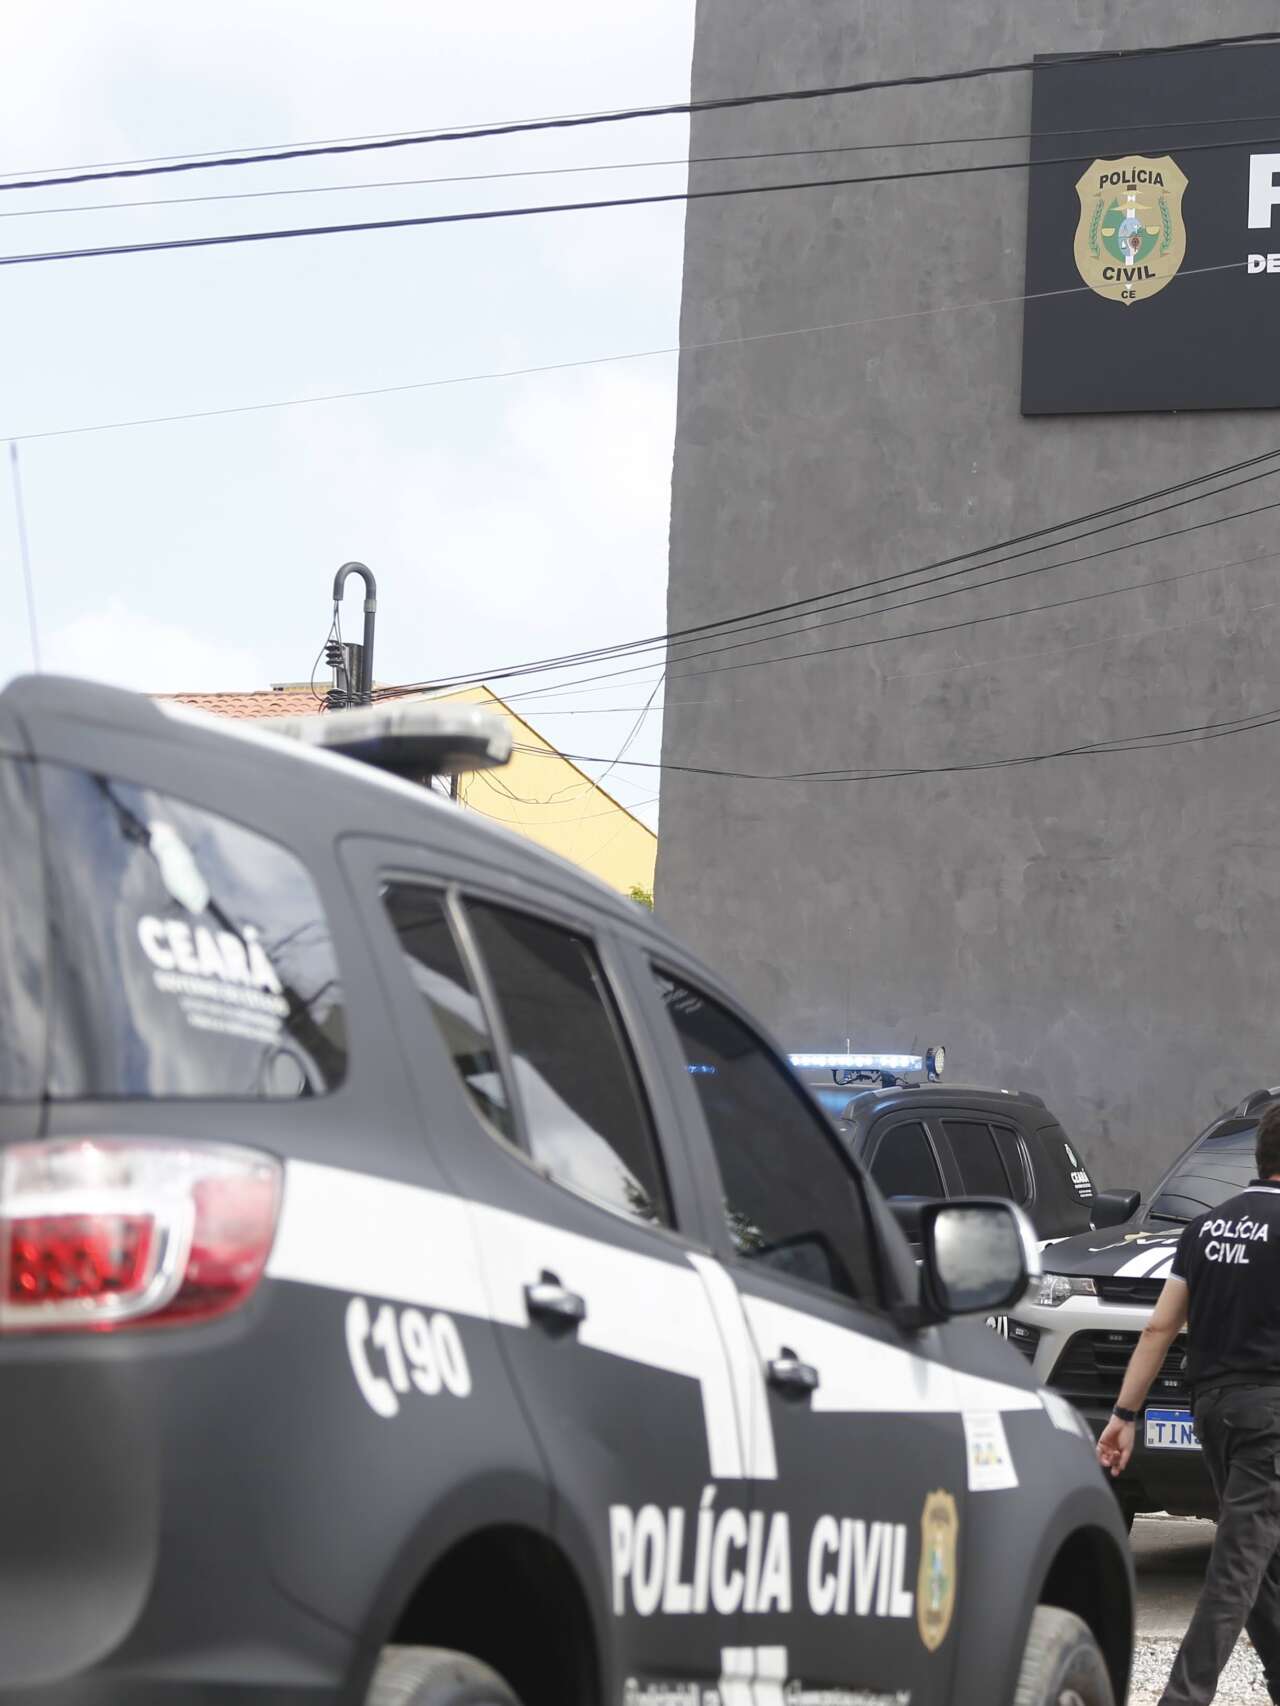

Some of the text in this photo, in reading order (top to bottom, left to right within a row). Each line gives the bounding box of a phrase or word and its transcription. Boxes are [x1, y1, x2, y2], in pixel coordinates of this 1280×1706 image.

[1099, 167, 1164, 190] POLÍCIA
[1102, 265, 1156, 282] CIVIL
[1120, 290, 1137, 299] CE
[138, 914, 283, 995] CEARÁ
[1199, 1215, 1269, 1242] POLÍCIA
[1204, 1240, 1250, 1264] CIVIL
[372, 1305, 472, 1398] 190
[1155, 1423, 1201, 1445] TIN
[609, 1484, 914, 1618] POLÍCIA CIVIL
